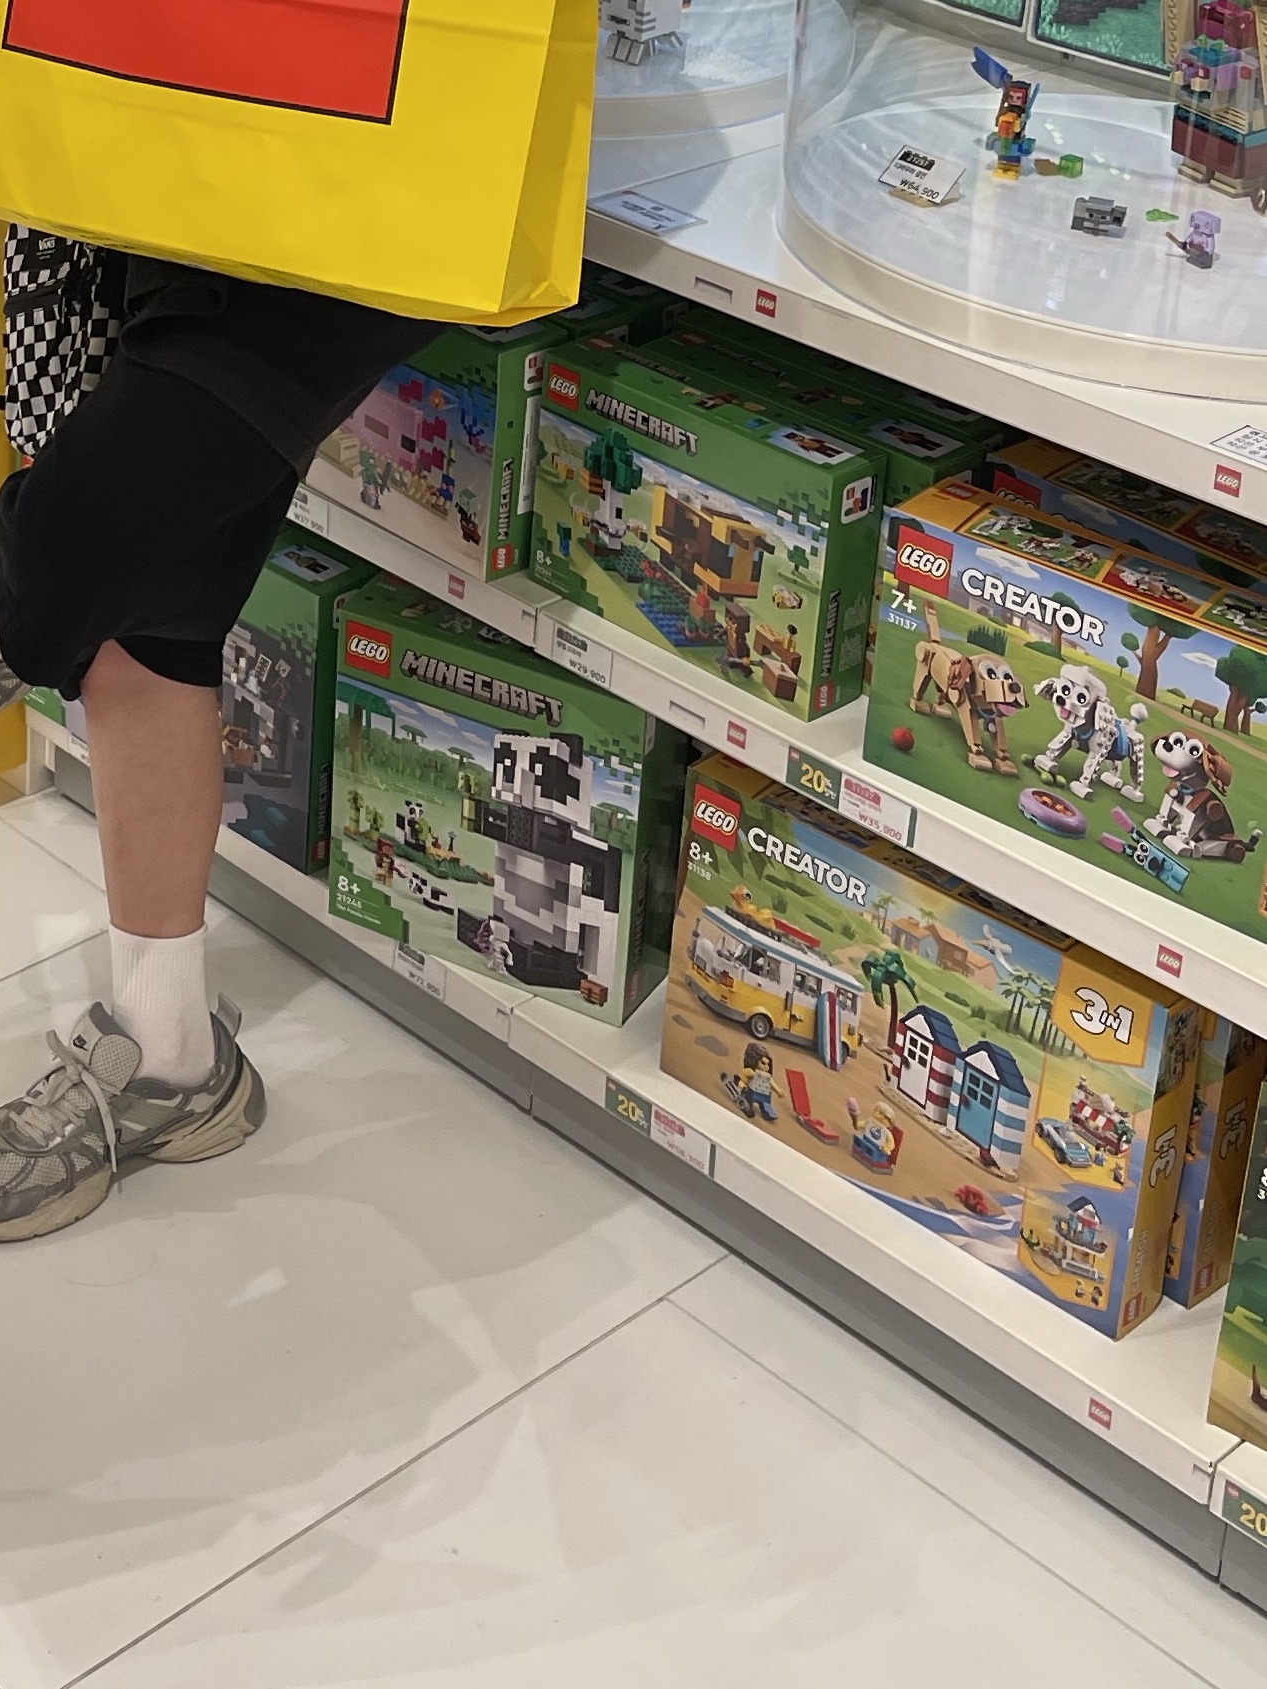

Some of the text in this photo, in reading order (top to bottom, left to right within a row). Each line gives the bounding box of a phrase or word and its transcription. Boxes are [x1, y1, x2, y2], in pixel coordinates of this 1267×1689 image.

[757, 298, 776, 310] LEGO
[549, 375, 699, 457] LEGO MINECRAFT
[536, 550, 552, 566] 8+
[891, 589, 917, 615] 7+
[898, 542, 1106, 647] LEGO CREATOR
[887, 612, 918, 632] 31137
[348, 634, 563, 728] LEGO MINECRAFT
[689, 841, 713, 865] 8+
[695, 800, 867, 907] LEGO CREATOR
[337, 875, 361, 895] 8+
